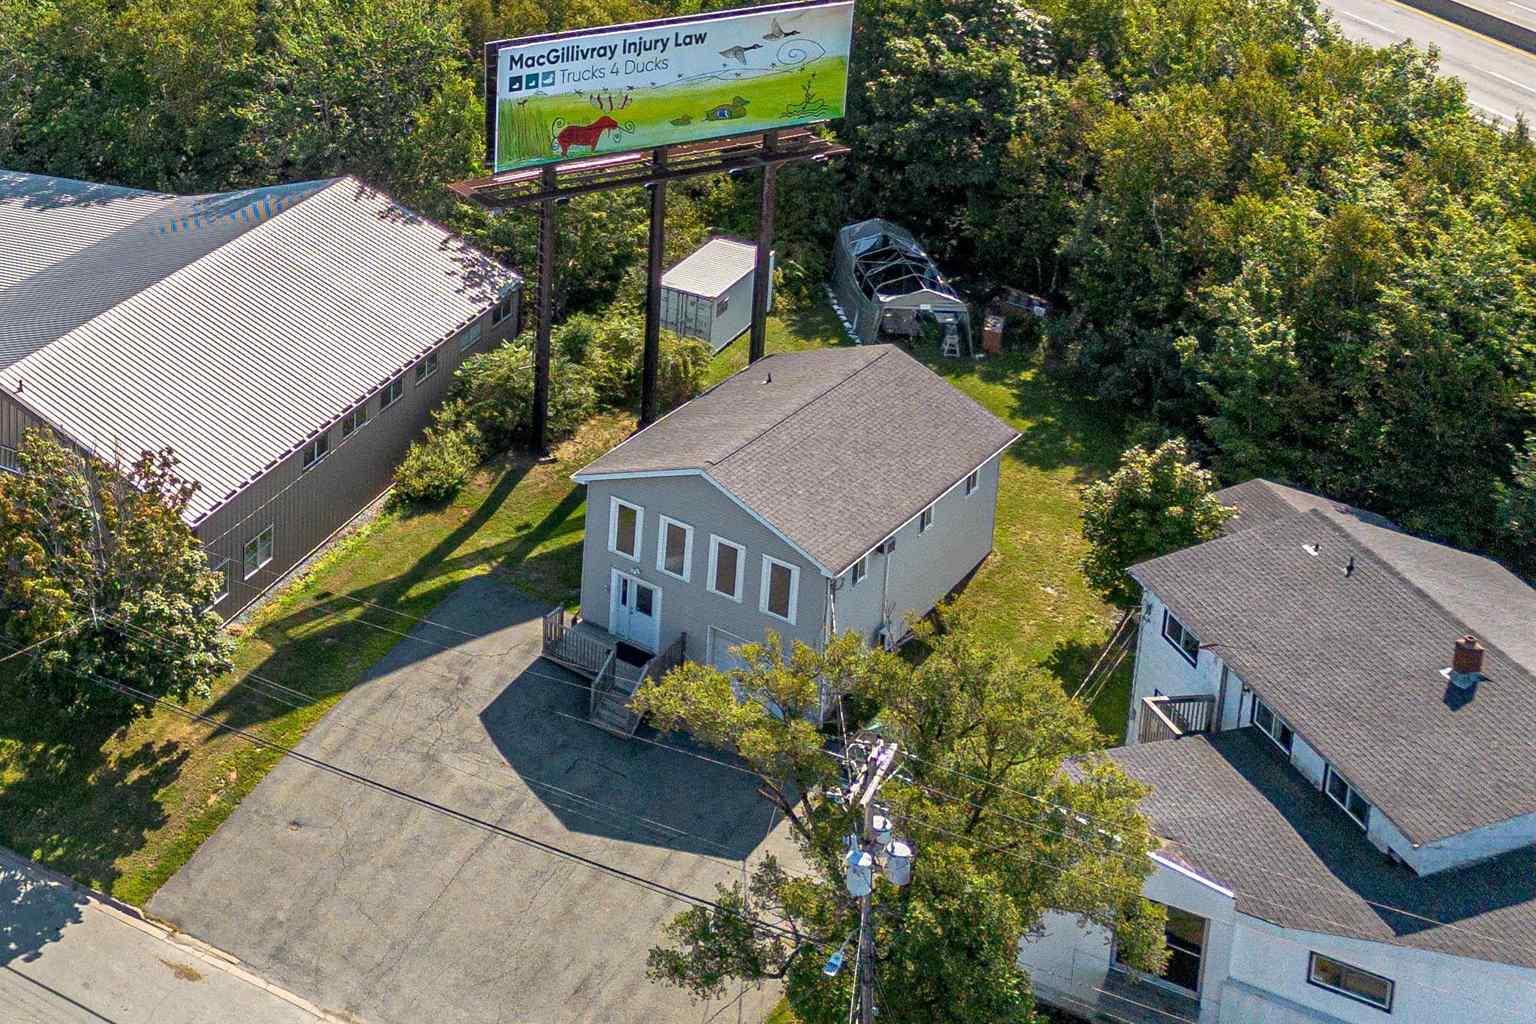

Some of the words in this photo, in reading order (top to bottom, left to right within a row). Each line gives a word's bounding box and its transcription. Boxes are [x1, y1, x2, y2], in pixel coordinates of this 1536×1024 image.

[509, 43, 618, 71] MacGillivray
[622, 36, 670, 57] Injury
[674, 32, 707, 47] Law
[559, 65, 606, 84] Trucks
[610, 62, 619, 76] 4
[624, 57, 669, 75] Ducks
